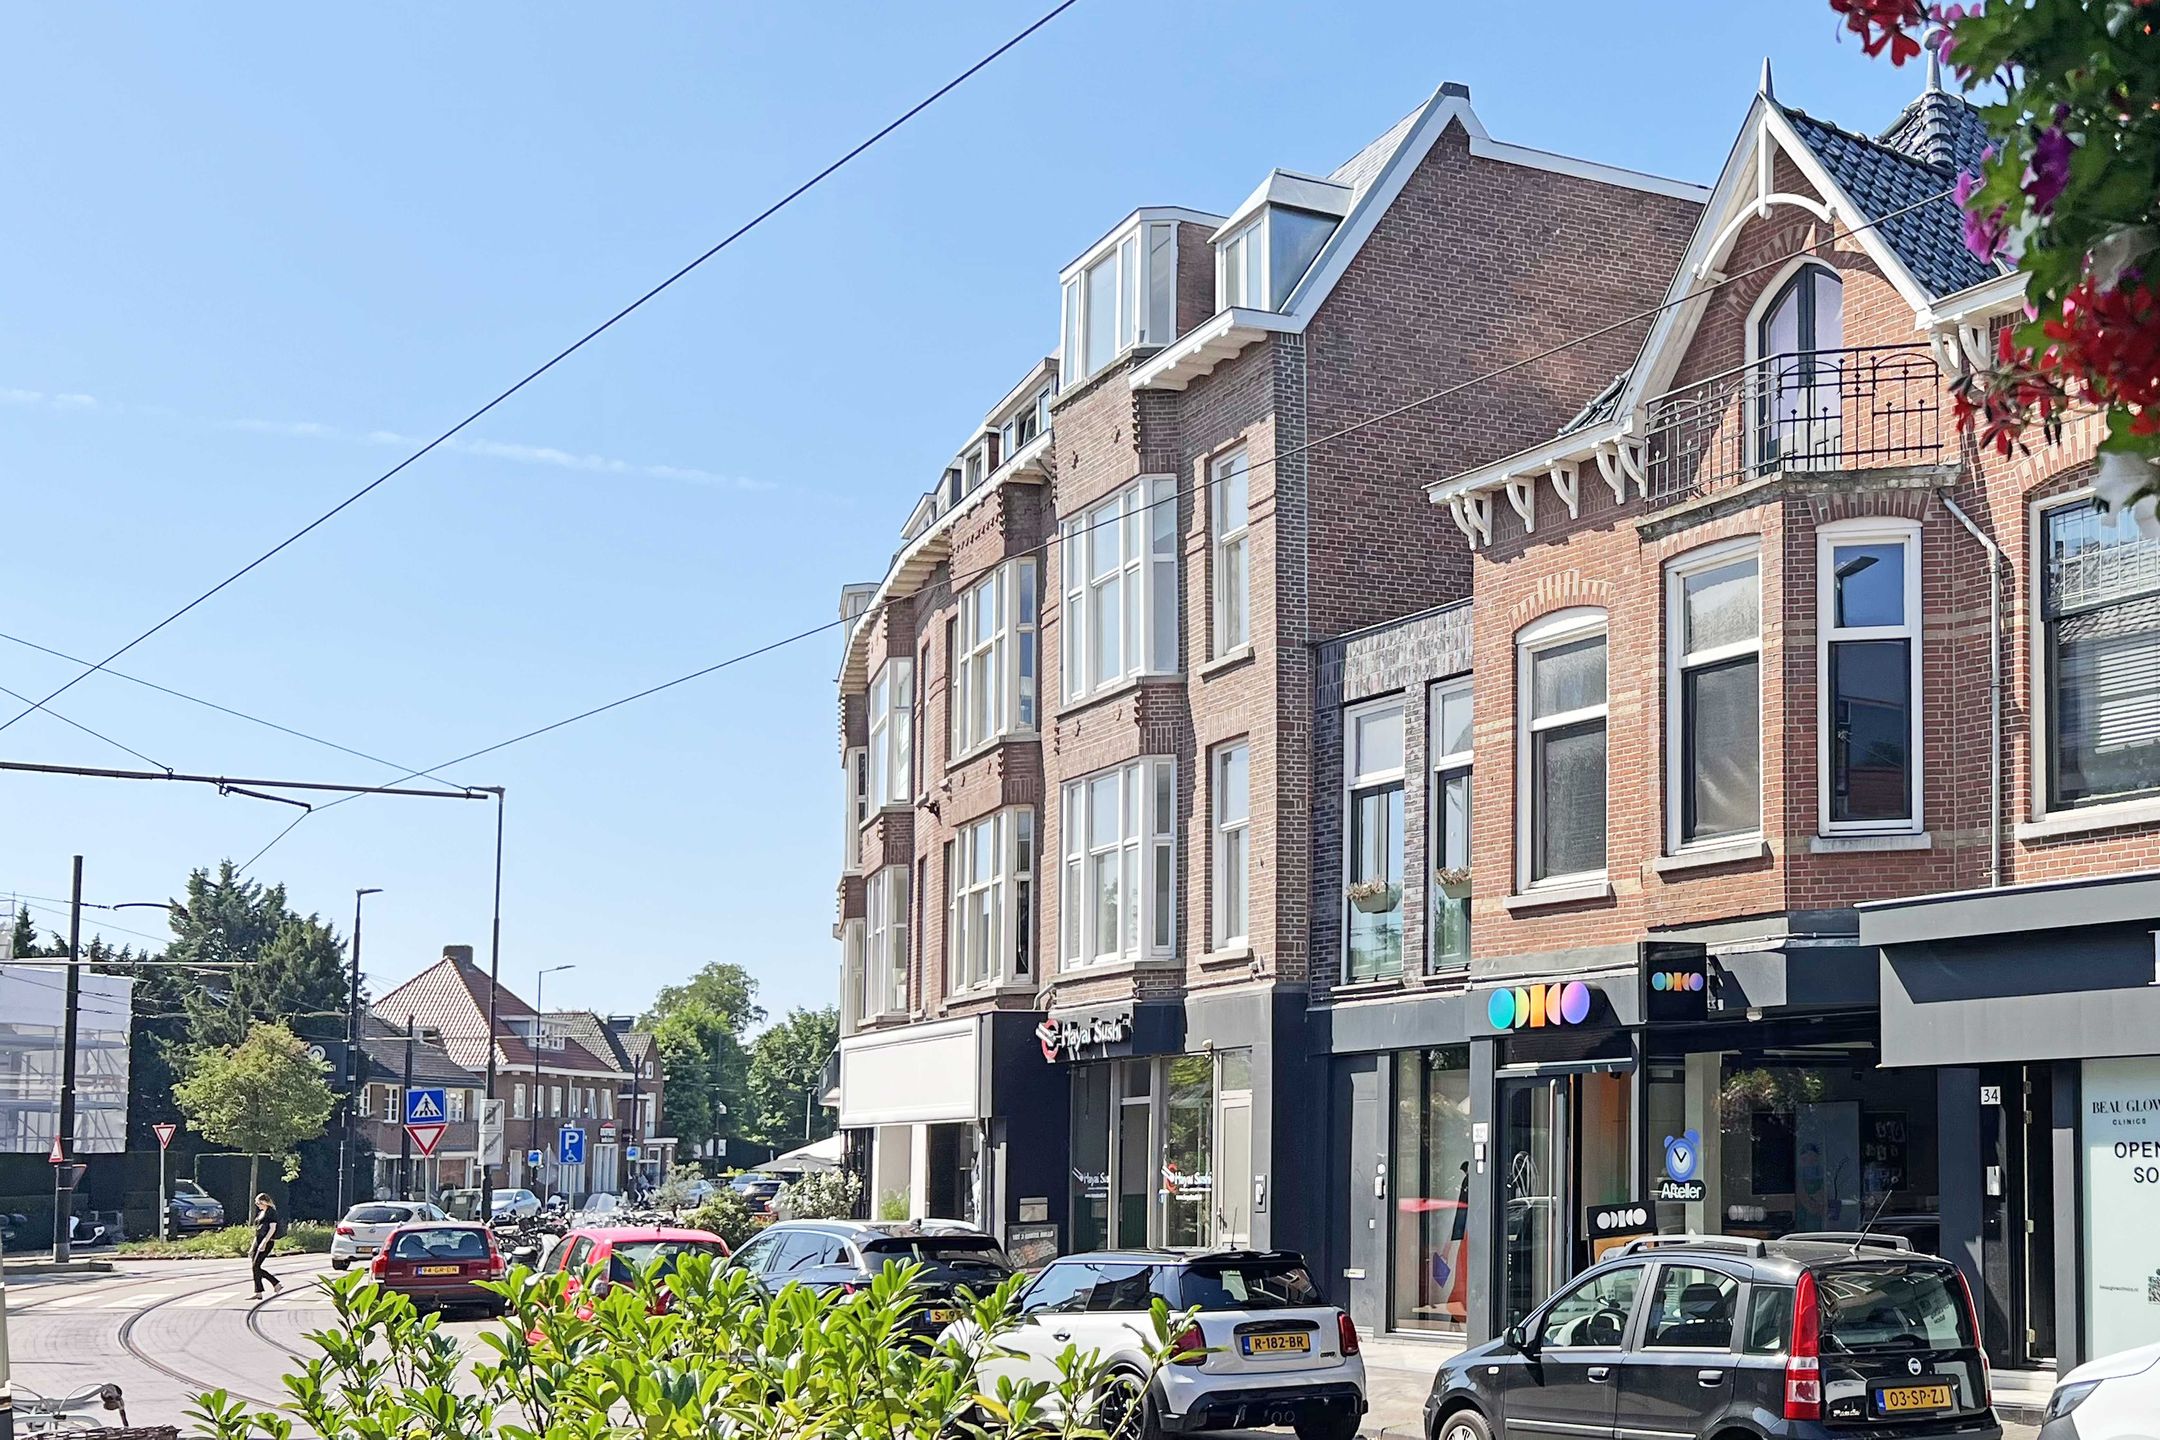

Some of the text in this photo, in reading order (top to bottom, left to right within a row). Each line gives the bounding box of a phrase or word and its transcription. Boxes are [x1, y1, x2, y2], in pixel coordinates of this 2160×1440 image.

[1093, 1014, 1123, 1043] Sushi
[1984, 1089, 1998, 1102] 34
[2092, 1101, 2123, 1114] BEAU
[565, 1132, 579, 1150] P
[1660, 1182, 1702, 1199] Afteller
[1254, 1336, 1305, 1350] R-182-BR
[1889, 1389, 1945, 1407] 03-SP-ZJ
